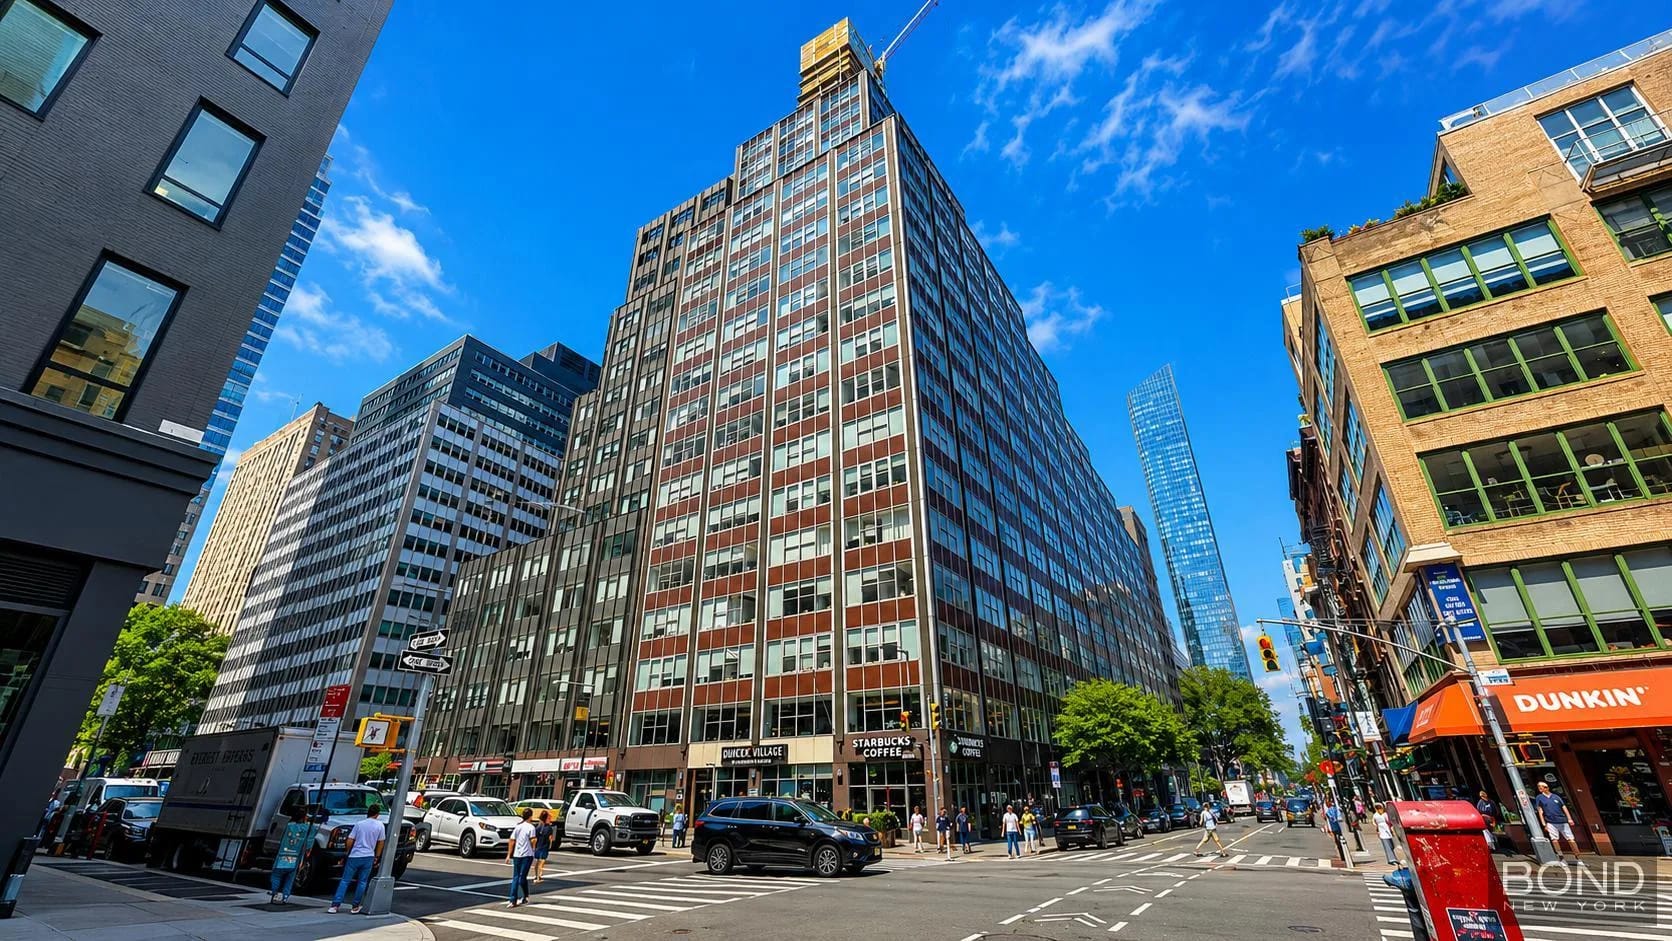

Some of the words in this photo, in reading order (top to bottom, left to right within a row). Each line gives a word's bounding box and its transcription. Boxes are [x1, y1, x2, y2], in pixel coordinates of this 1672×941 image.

[1513, 686, 1645, 713] DUNKIN'
[852, 736, 911, 748] STARBUCKS
[752, 746, 783, 757] VILLAGE
[863, 747, 902, 758] COFFEE
